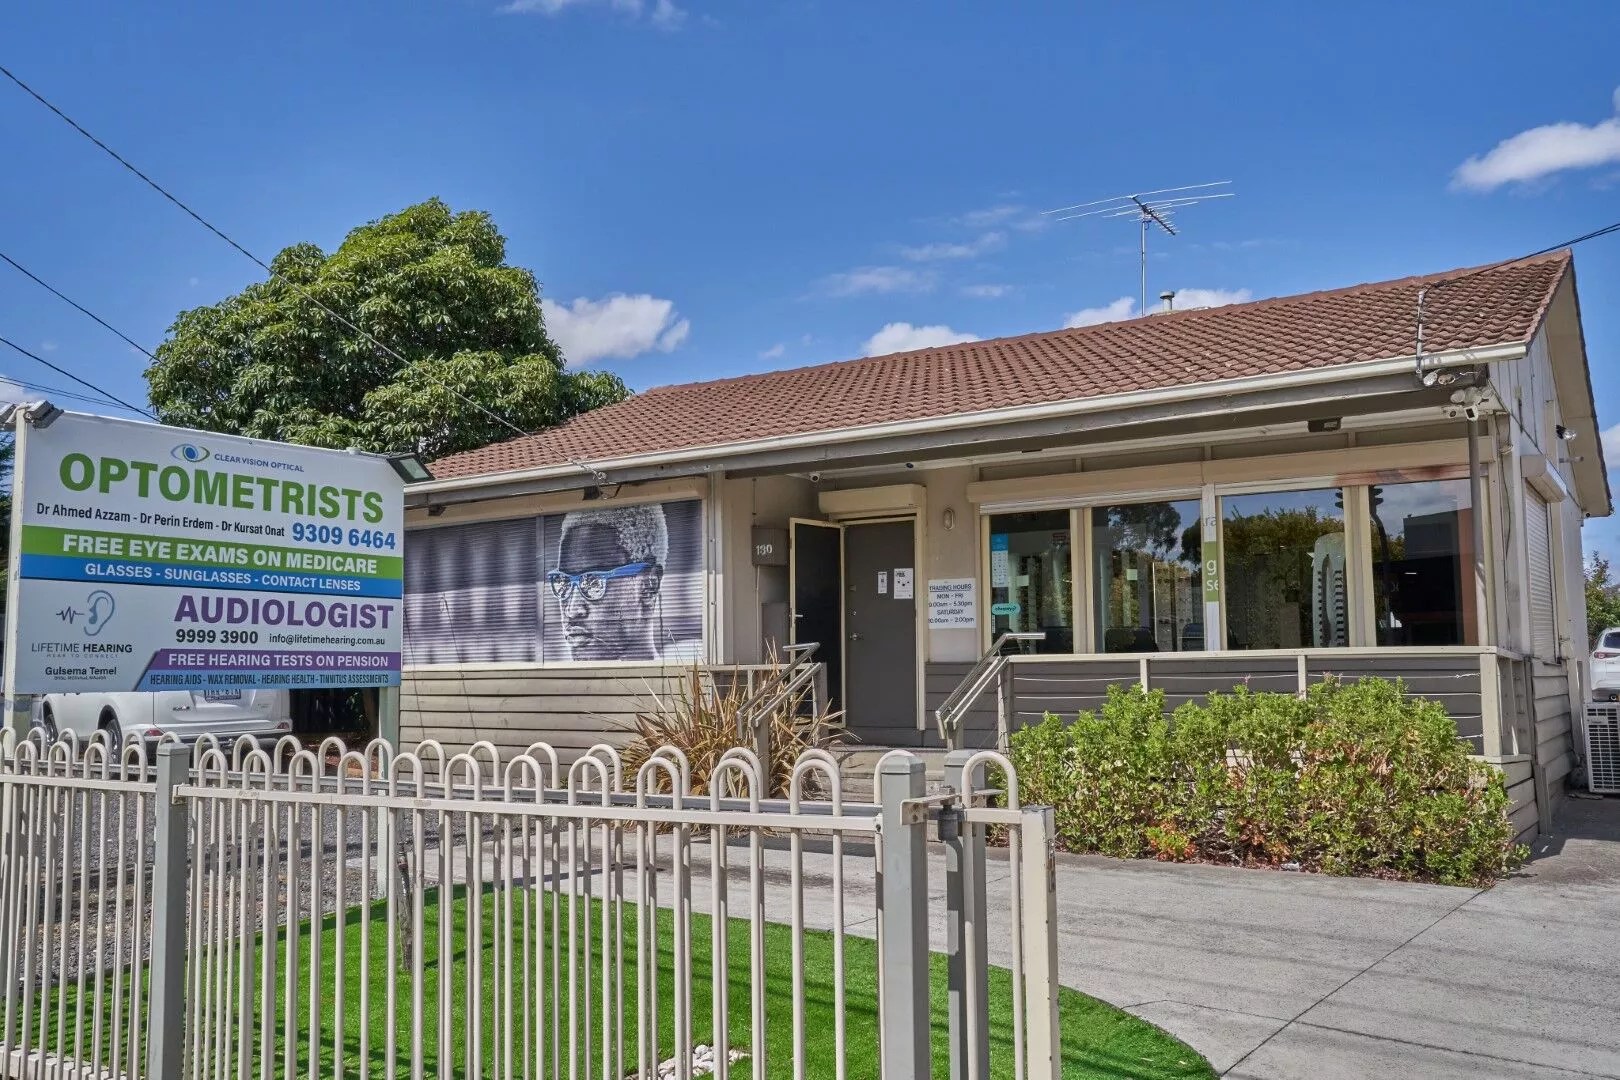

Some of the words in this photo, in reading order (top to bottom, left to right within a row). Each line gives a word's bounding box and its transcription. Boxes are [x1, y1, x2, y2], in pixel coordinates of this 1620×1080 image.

[215, 453, 241, 463] CLEAR
[242, 457, 269, 467] VISION
[271, 461, 305, 473] OPTICAL
[59, 453, 384, 524] OPTOMETRISTS
[37, 503, 50, 515] Dr
[52, 504, 92, 519] Ahmed
[95, 508, 131, 522] Azzam
[140, 513, 152, 524] Dr
[154, 514, 180, 527] Perin
[182, 517, 213, 530] Erdem
[222, 521, 232, 531] Dr
[234, 522, 263, 535] Kursat
[265, 526, 285, 537] Onat
[292, 522, 343, 545] 9309
[348, 528, 396, 550] 6464
[63, 533, 124, 556] FREE
[129, 539, 171, 559] EYE
[176, 543, 249, 565] EXAMS
[253, 549, 281, 568] ON
[285, 552, 377, 574] MEDICARE
[85, 563, 153, 578] GLASSES
[164, 568, 251, 584] SUNGLASSES
[262, 574, 317, 589] CONTACT
[319, 578, 361, 591] LENSES
[173, 594, 394, 629] AUDIOLOGIST
[176, 629, 217, 644] 9999
[220, 630, 259, 644] 3900
[269, 633, 386, 646] info@lifetimehearing.com.au
[31, 643, 80, 653] LIFETIME
[83, 643, 133, 653] HEARING
[168, 654, 205, 666] FREE
[209, 654, 271, 667] HEARING
[274, 655, 313, 667] TESTS
[316, 655, 335, 667] ON
[338, 656, 389, 668] PENSION
[45, 667, 87, 676] Gulsema
[90, 667, 117, 676] Temel
[150, 674, 184, 685] HEARING
[184, 674, 202, 685] AIDS
[207, 674, 224, 685] WAX
[225, 674, 257, 685] REMOVAL
[262, 673, 290, 684] HEARING
[291, 673, 315, 684] HEALTH
[320, 674, 347, 684] TINNITUS
[348, 674, 390, 684] ASSESSMENTS
